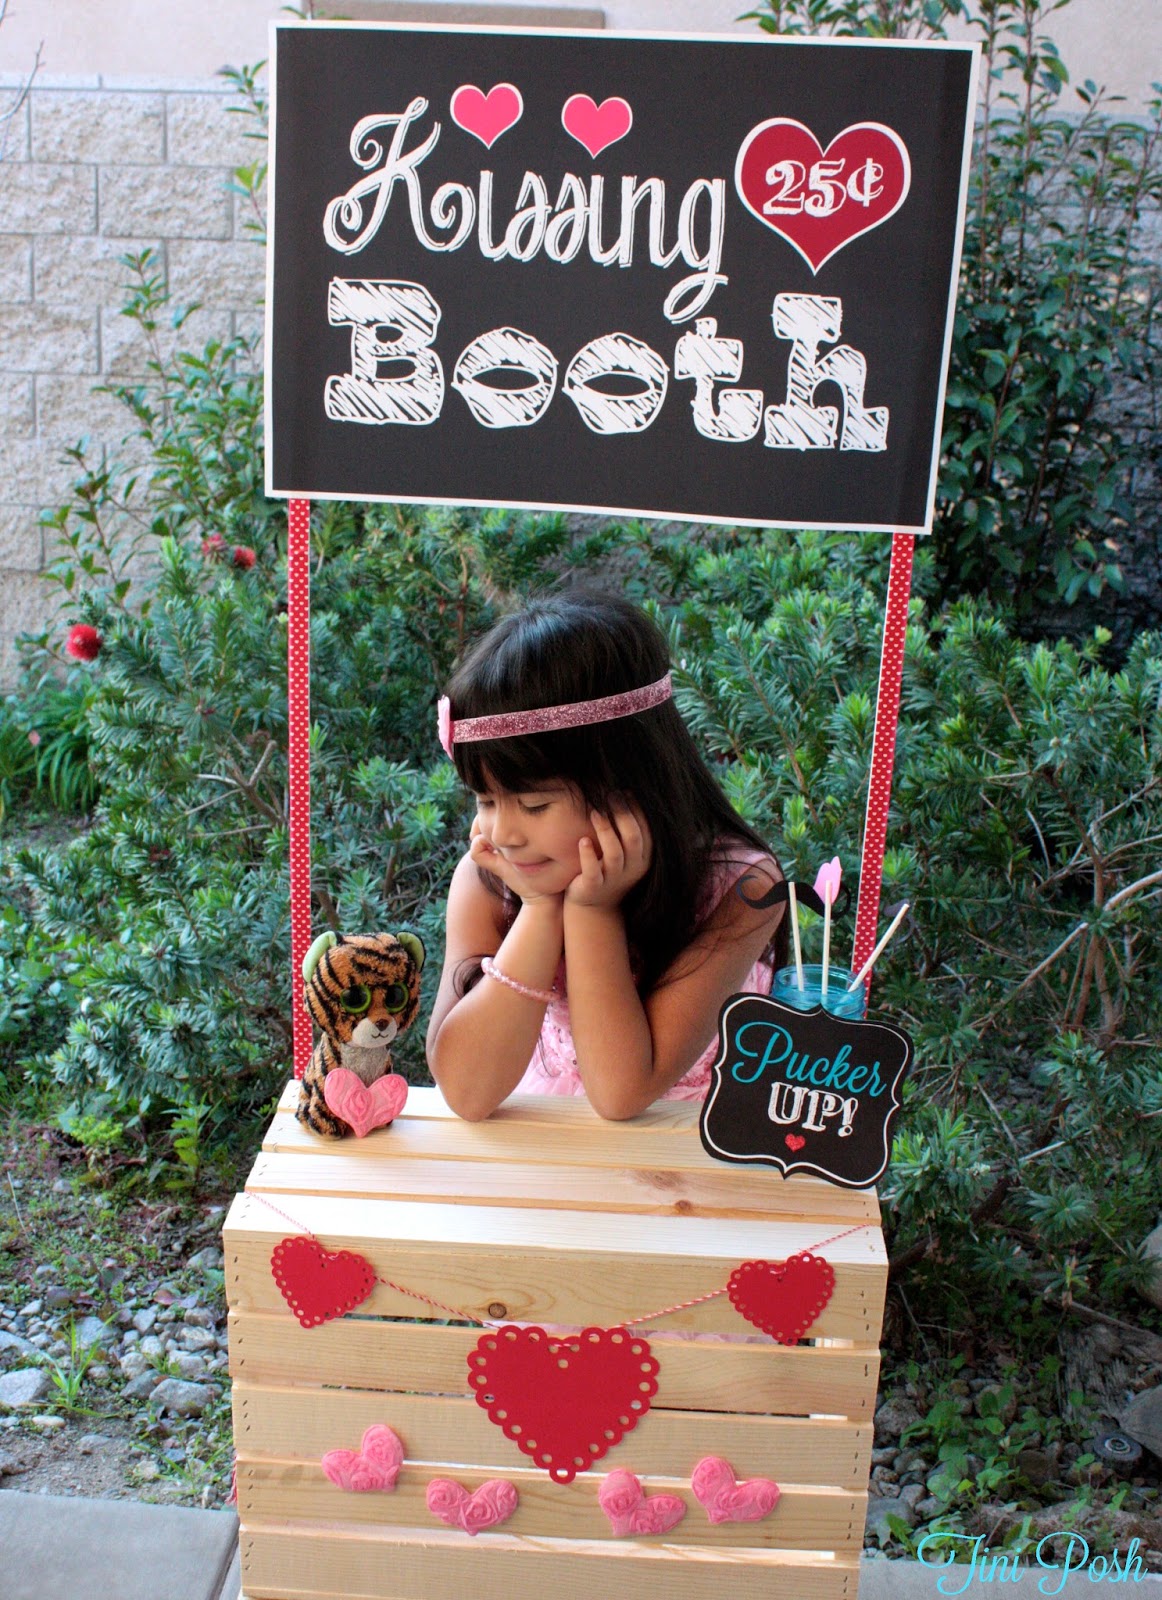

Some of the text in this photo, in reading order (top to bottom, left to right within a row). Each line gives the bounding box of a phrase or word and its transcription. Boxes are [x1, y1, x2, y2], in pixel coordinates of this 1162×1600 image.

[323, 97, 728, 324] Kissing
[762, 156, 885, 218] 25¢
[324, 276, 889, 452] Booth
[731, 1021, 887, 1097] Pucker
[767, 1081, 859, 1137] UP!
